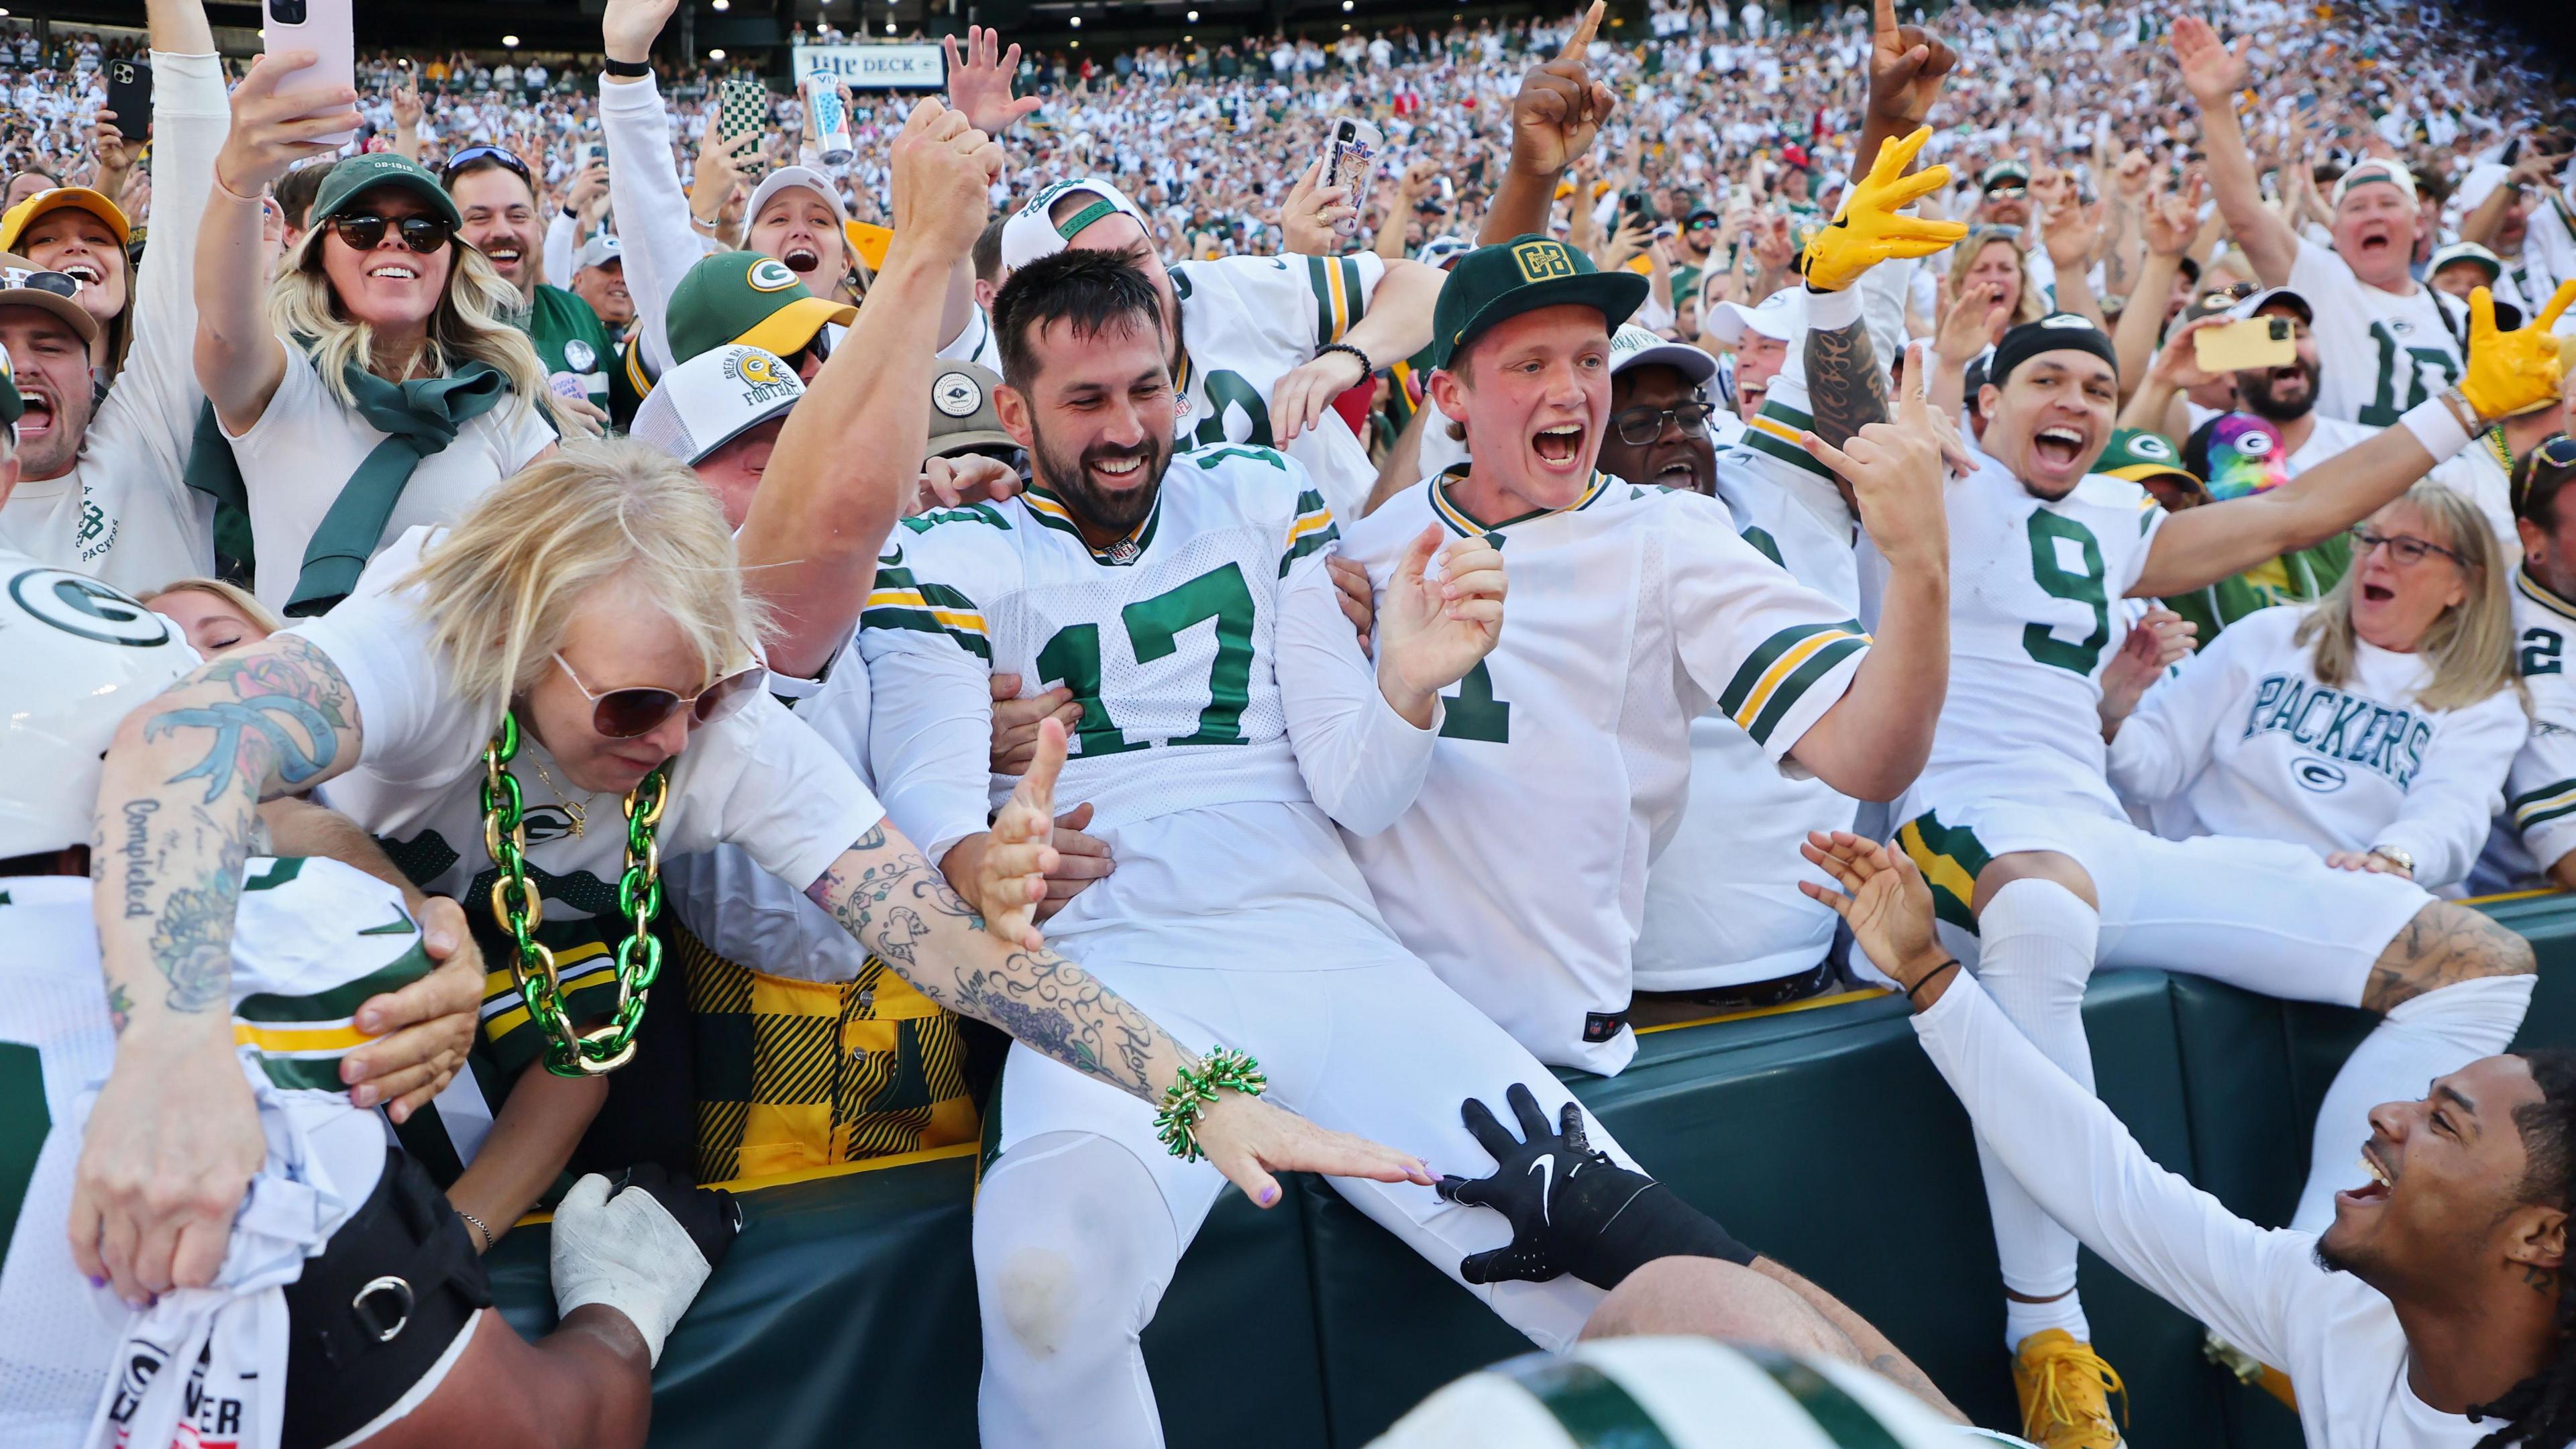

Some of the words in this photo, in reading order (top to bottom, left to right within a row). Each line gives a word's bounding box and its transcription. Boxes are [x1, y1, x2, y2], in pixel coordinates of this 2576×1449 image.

[863, 59, 914, 72] DECK
[723, 355, 737, 380] GREEN
[729, 347, 745, 358] BAY
[83, 518, 119, 562] PACKERS
[1112, 544, 1136, 561] NFL
[2023, 506, 2110, 678] 9
[1036, 561, 1256, 759] 17
[2240, 672, 2434, 794] PACKERS
[115, 798, 160, 919] Completed
